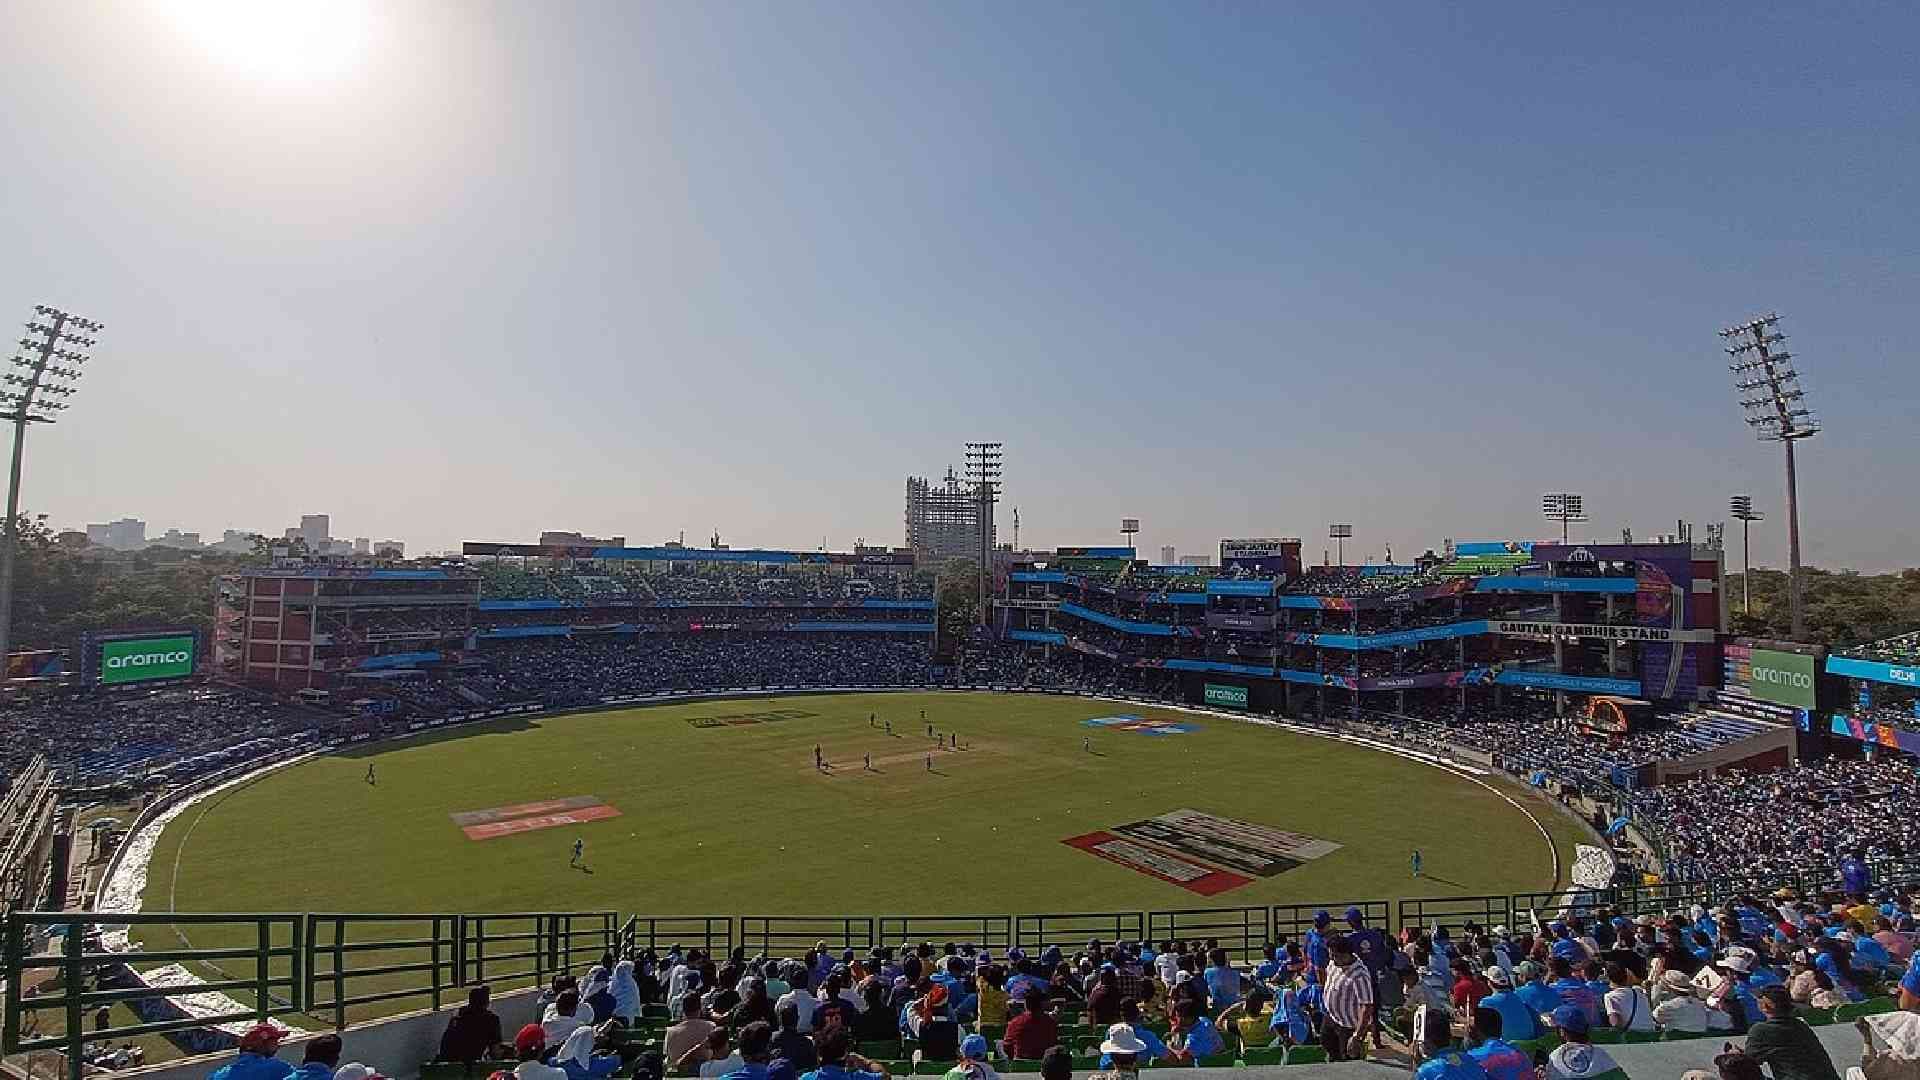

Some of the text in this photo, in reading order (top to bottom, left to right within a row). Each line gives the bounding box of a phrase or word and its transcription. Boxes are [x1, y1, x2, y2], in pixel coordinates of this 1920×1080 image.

[1500, 622, 1669, 640] GAUTAM GAMBHIR STAND
[107, 652, 189, 668] aramco
[1752, 667, 1811, 689] aramco
[1889, 669, 1916, 681] DELHI
[1206, 689, 1247, 702] aramco
